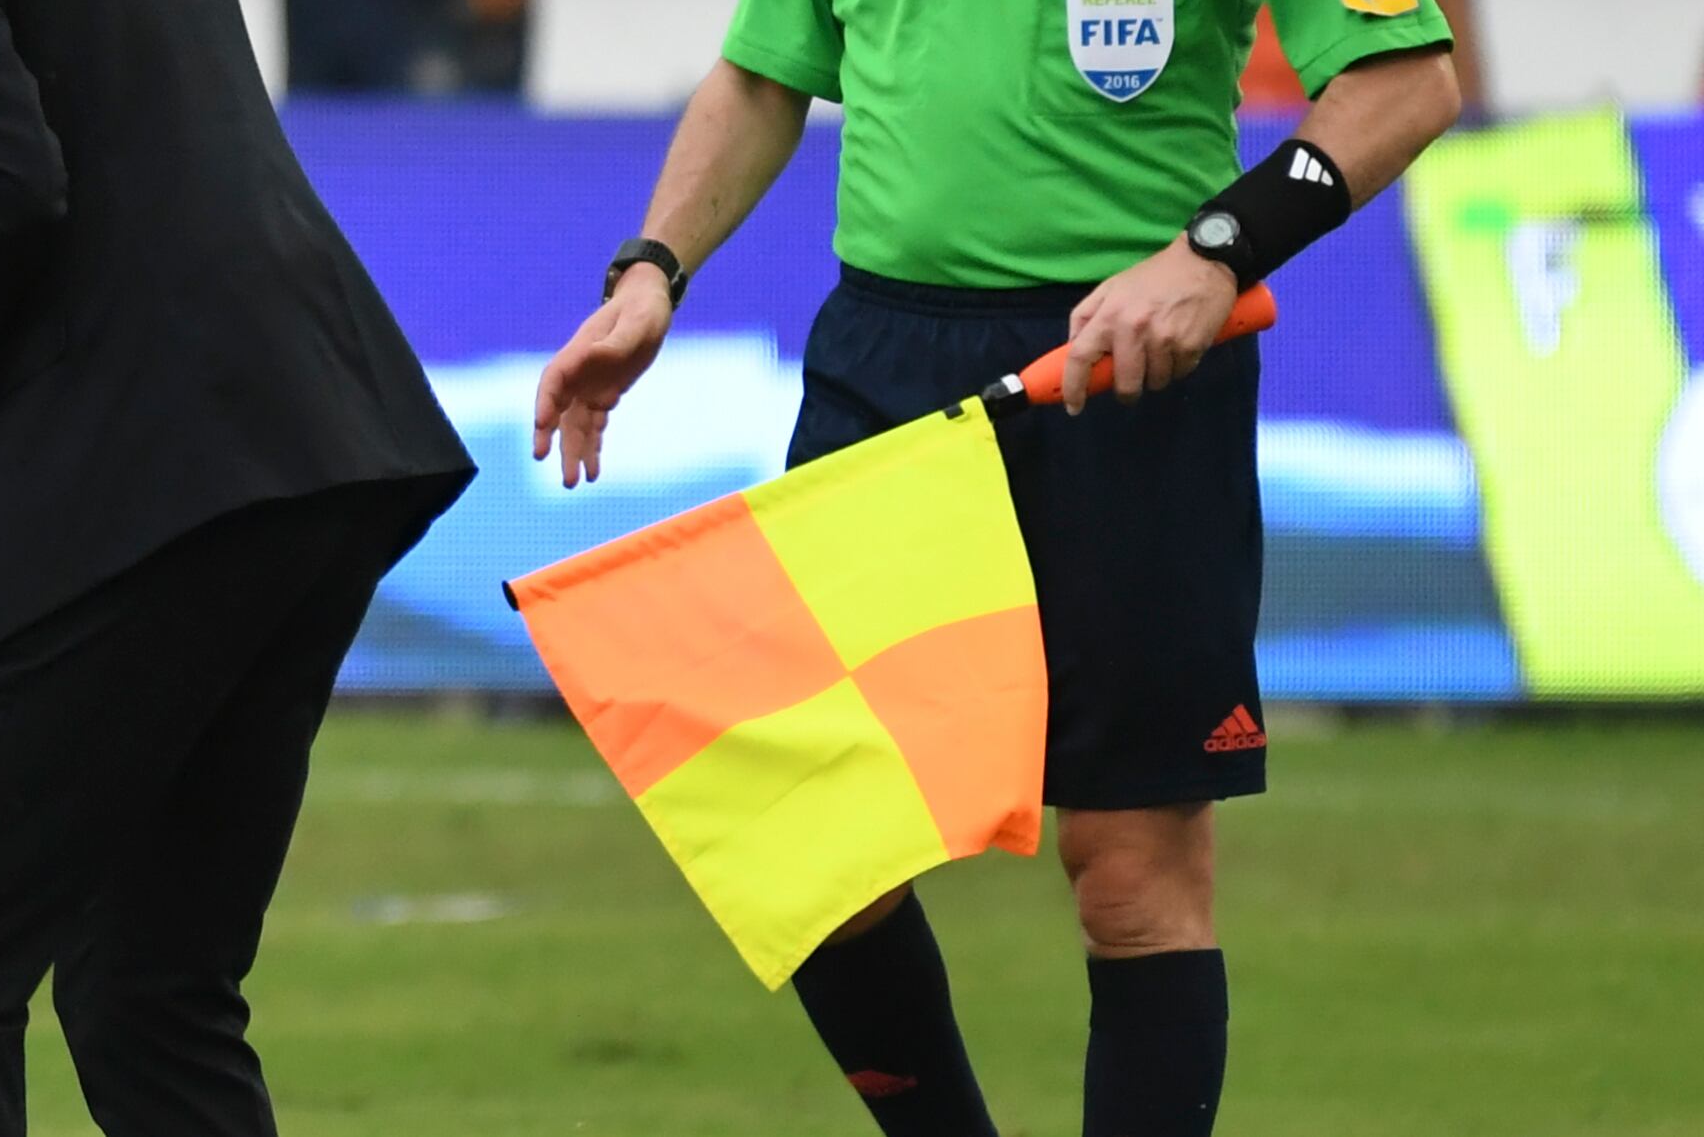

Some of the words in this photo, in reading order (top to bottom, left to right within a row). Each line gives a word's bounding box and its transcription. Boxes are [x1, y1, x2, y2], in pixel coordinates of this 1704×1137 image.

[1080, 18, 1161, 47] FIFA
[1103, 75, 1140, 90] 2016
[1203, 733, 1266, 752] adidas
